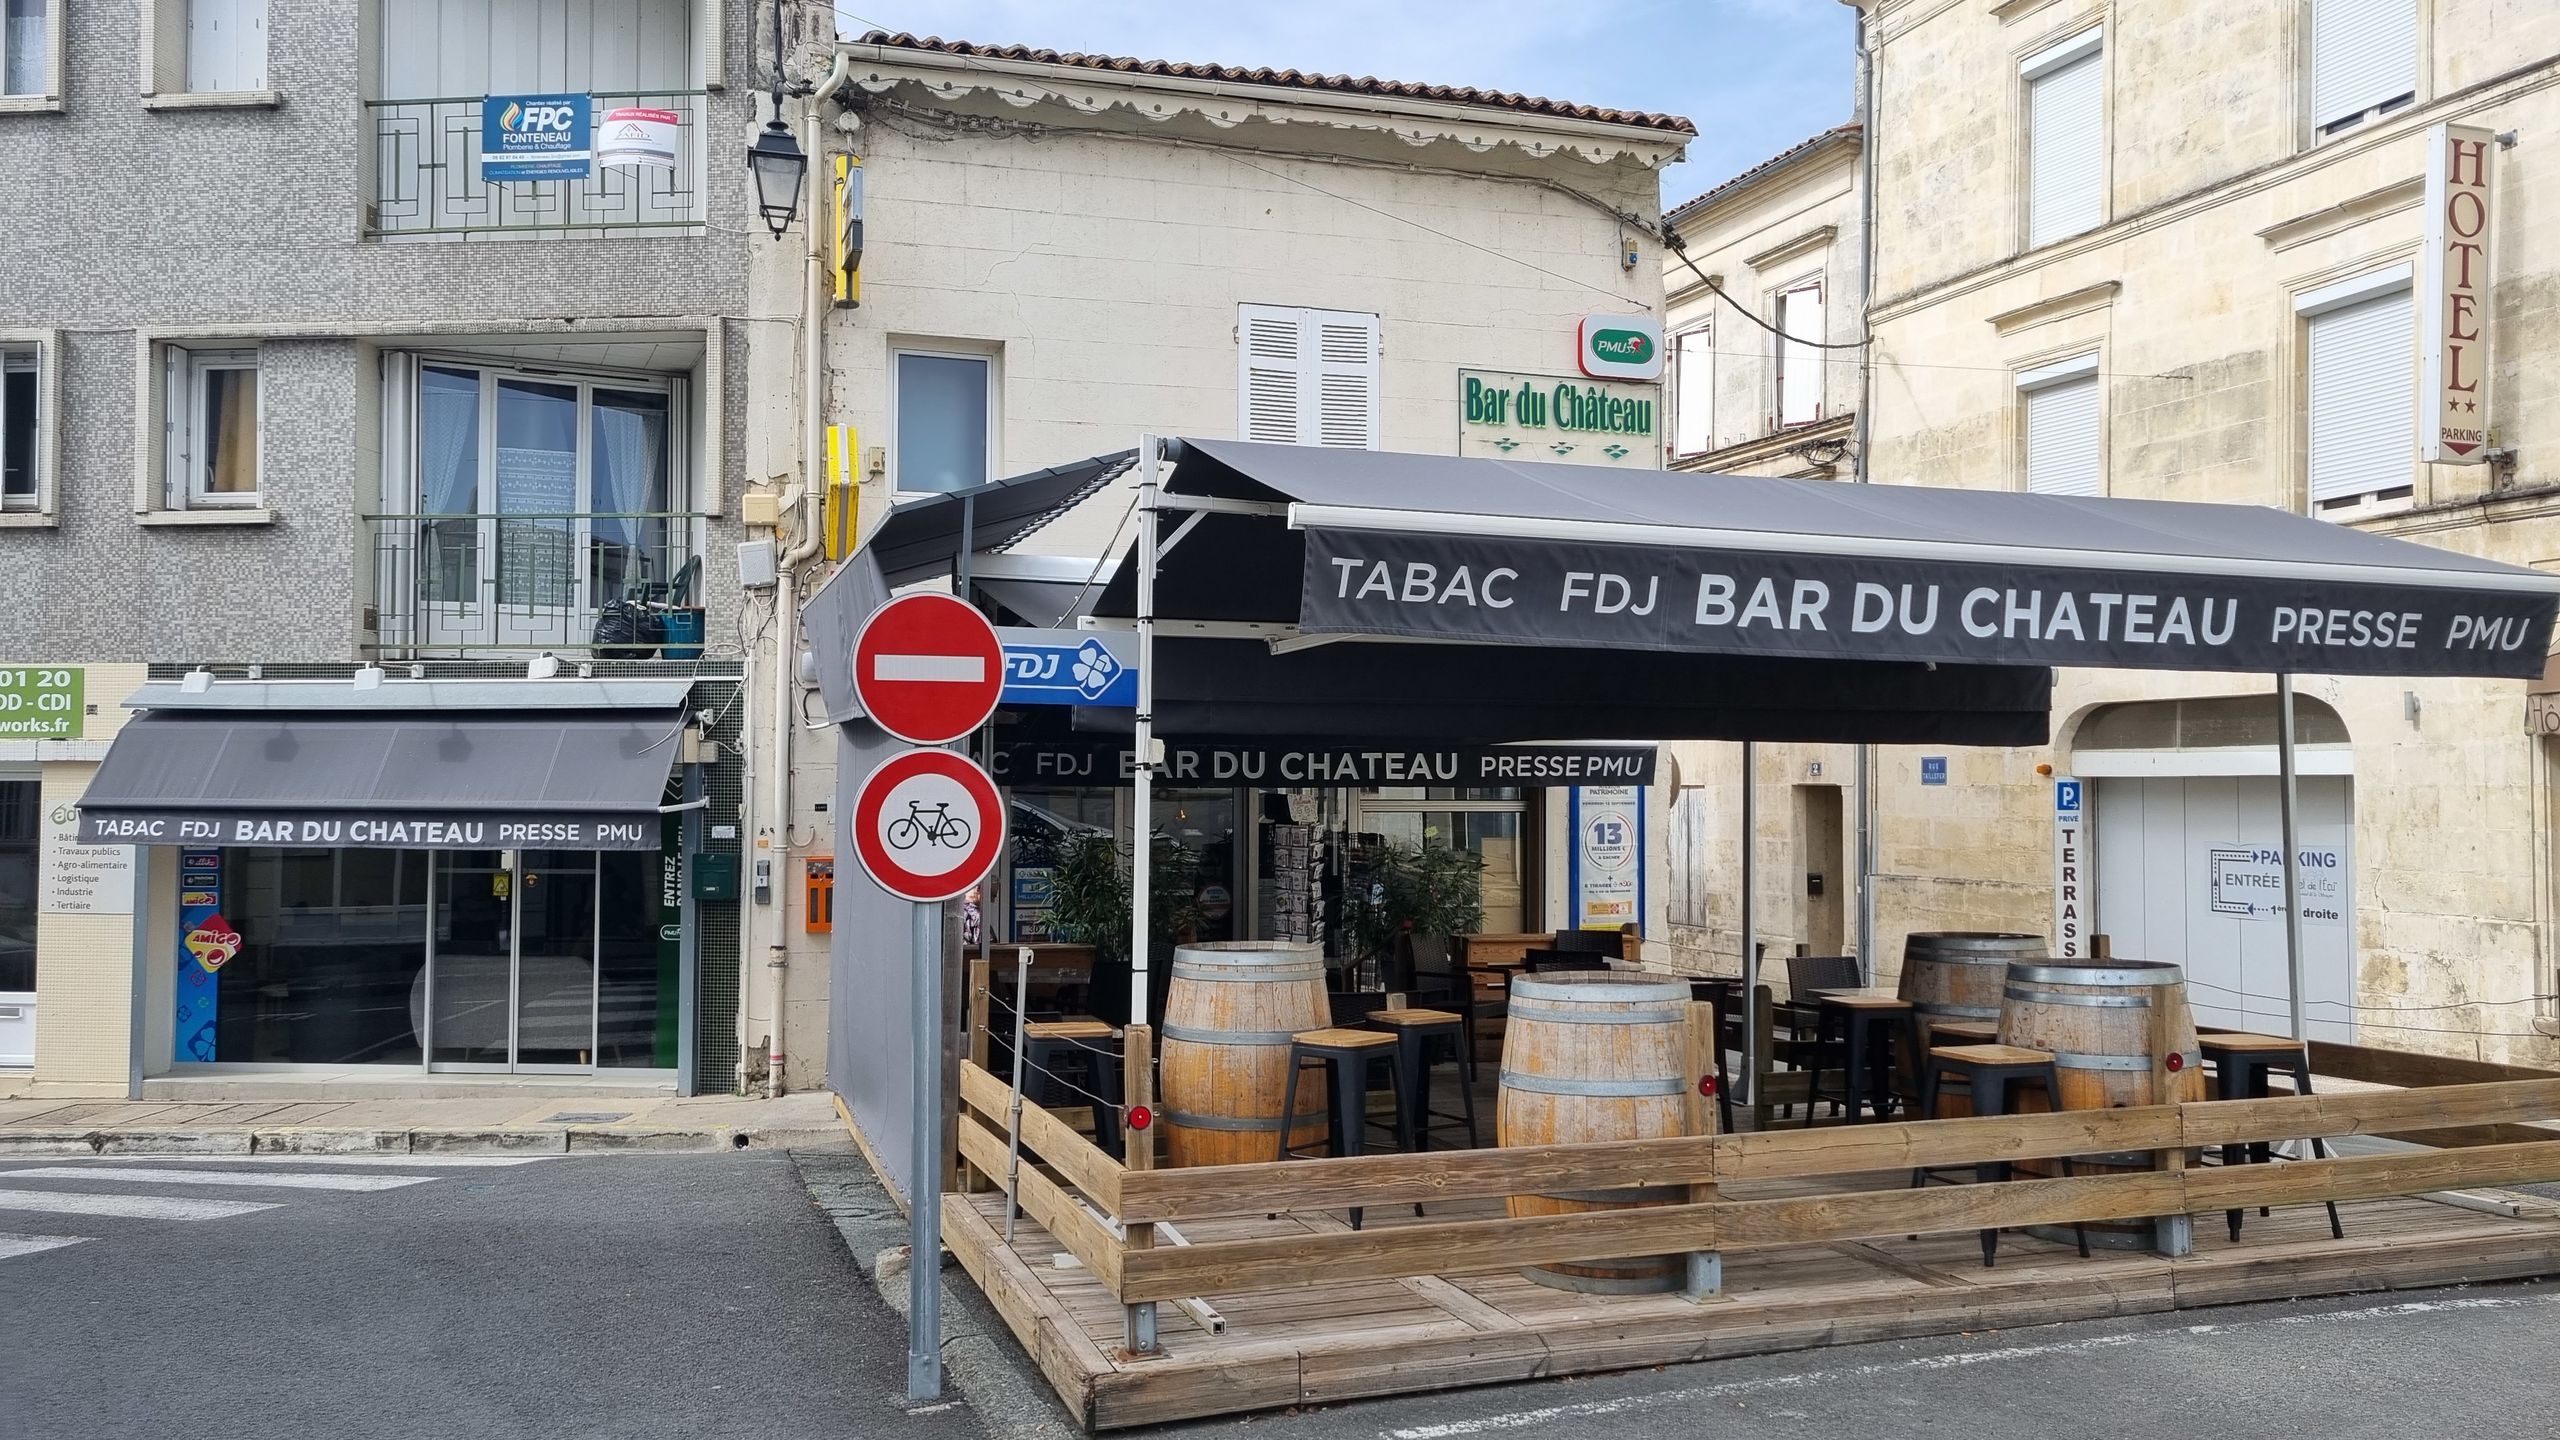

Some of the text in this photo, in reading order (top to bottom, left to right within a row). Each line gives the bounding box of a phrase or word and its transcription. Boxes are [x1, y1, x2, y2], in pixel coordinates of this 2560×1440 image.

[521, 106, 574, 132] FPC
[502, 132, 571, 144] FONTENEAU
[2448, 138, 2487, 392] HOTEL
[1597, 340, 1626, 354] PMU
[1466, 377, 1653, 436] Bar du Château
[2441, 427, 2483, 443] PARKING
[1331, 557, 2531, 651] TABAC FDJ BAR DU CHATEAU PRESSE PMU
[1005, 652, 1060, 680] FDJ
[37, 670, 71, 688] 20
[37, 693, 71, 711] CDI
[1036, 752, 1093, 776] FDJ
[1119, 751, 1200, 780] BR
[1214, 751, 1266, 780] DU
[1280, 752, 1458, 781] CHATEAU
[1481, 755, 1581, 778] PRESSE
[1586, 756, 1643, 778] PMU
[1812, 763, 1819, 773] 2
[2058, 815, 2079, 823] PRIVÉ
[95, 820, 642, 843] TABAC FDJ BAR DU CHATEAU PRESSE PMU
[1594, 823, 1623, 845] 13
[58, 847, 121, 858] Travaux publics
[2261, 850, 2337, 868] PAKING
[58, 861, 128, 871] Agro-alimentaire
[57, 874, 100, 884] Logistique
[664, 856, 676, 907] ENTREZ
[2225, 872, 2280, 888] ENTRÉE
[57, 888, 93, 896] Industrie
[2062, 829, 2077, 958] TERRASS
[57, 901, 91, 910] Tertiaire
[2303, 908, 2339, 920] droite
